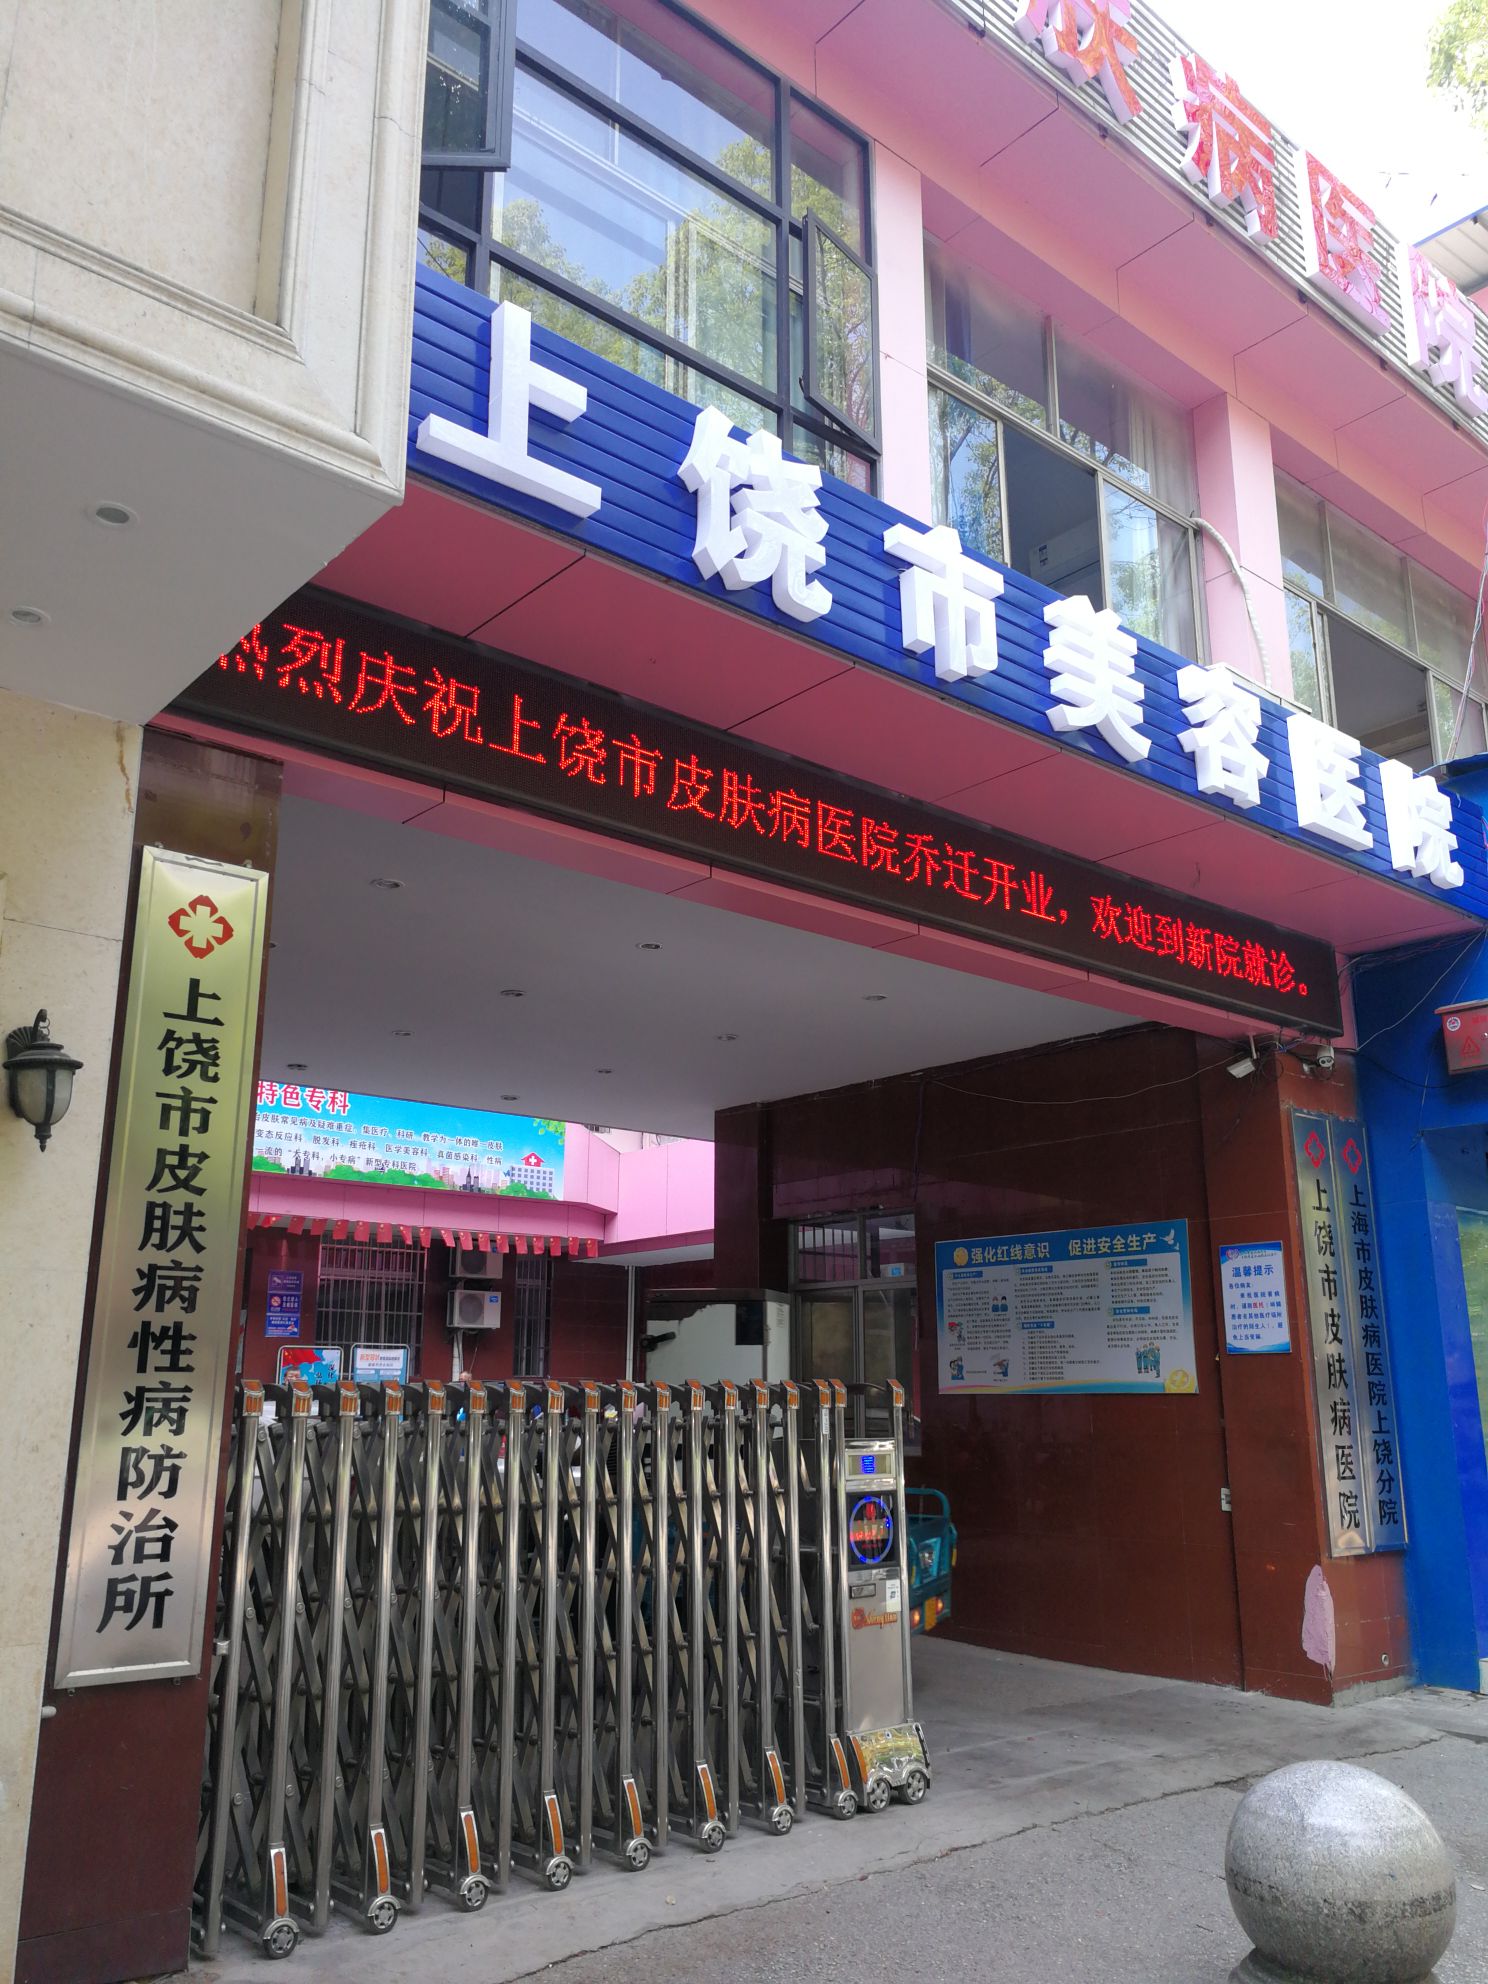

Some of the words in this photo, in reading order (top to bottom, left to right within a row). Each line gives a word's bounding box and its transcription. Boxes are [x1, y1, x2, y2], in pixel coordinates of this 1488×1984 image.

[416, 300, 1464, 889] 上饶市美容医院
[96, 977, 224, 1634] 上饶市皮肤病性病防治所
[971, 1242, 1051, 1265] 强化红线意识
[1068, 1232, 1158, 1257] 促进安全生产
[1232, 1264, 1274, 1278] 温馨提示
[1312, 1178, 1361, 1530] 上饶市皮肤病医院
[1348, 1184, 1399, 1526] 上海市皮肤病医院上饶分院
